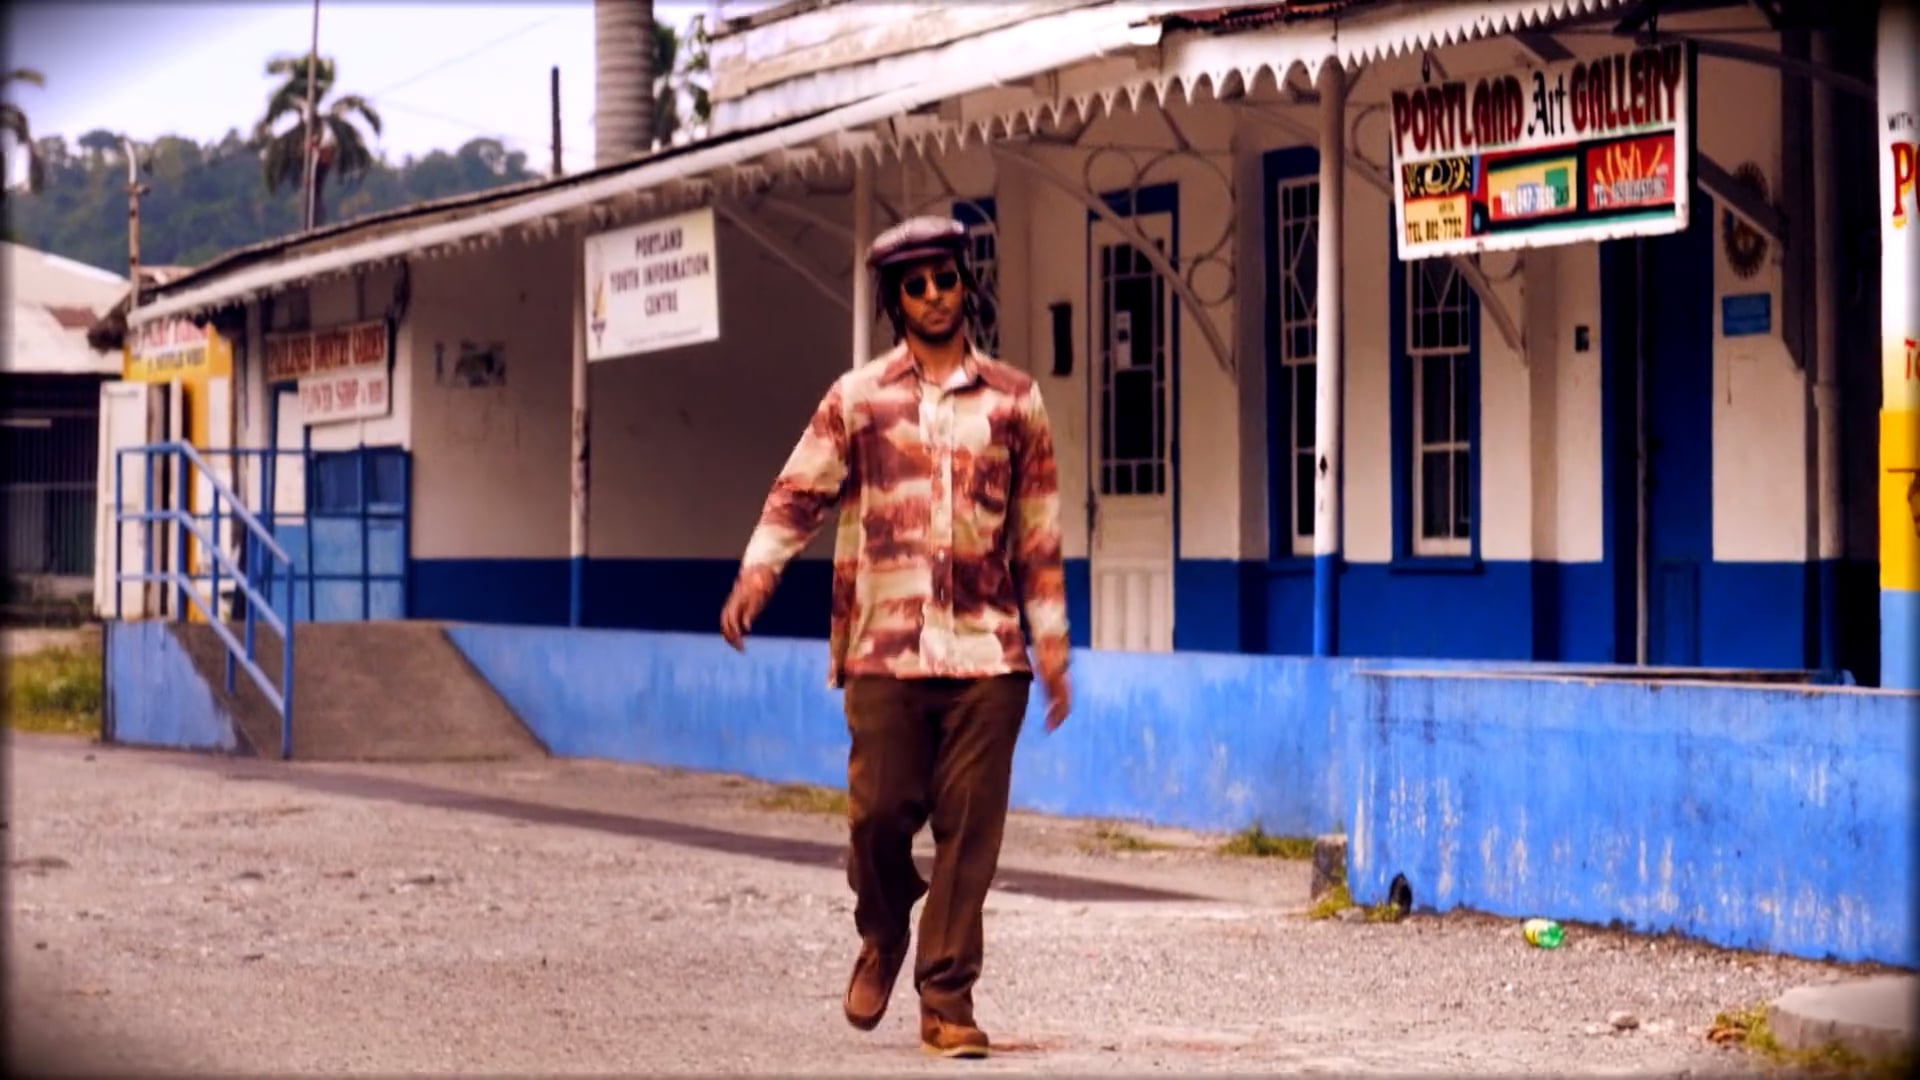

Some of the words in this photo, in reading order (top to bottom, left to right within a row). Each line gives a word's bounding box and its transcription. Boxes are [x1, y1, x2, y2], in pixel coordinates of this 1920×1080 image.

[1391, 76, 1524, 156] PORTLAND
[1527, 71, 1568, 137] Art
[1570, 45, 1683, 134] GALLERY
[635, 228, 683, 259] PORTLAND
[1407, 221, 1422, 244] TEL
[610, 266, 640, 295] YOUTH
[643, 252, 710, 286] INFORMATION
[644, 290, 678, 317] CENTRE
